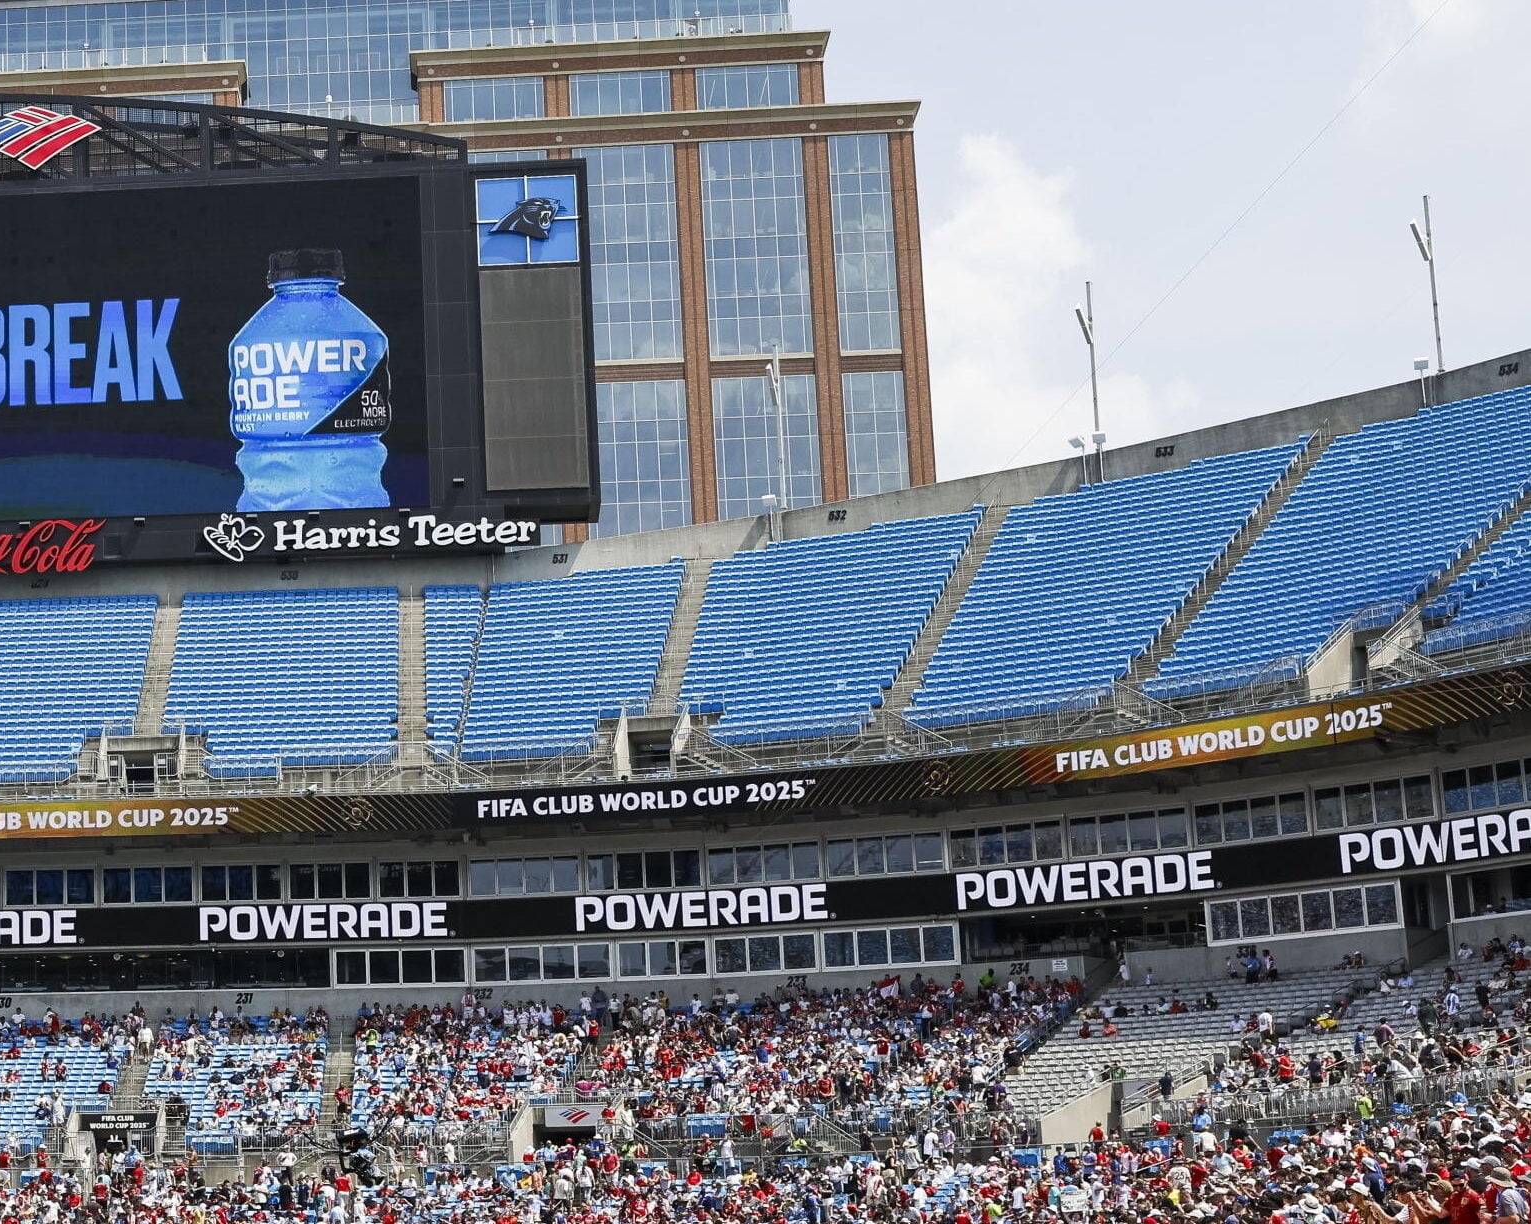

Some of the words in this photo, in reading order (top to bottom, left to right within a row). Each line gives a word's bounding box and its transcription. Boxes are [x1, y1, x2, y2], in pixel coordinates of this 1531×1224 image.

[234, 339, 366, 377] POWER
[1498, 363, 1519, 376] 534
[234, 375, 301, 410] ADE
[275, 411, 309, 421] BERRY
[363, 406, 386, 418] MORE
[1155, 445, 1175, 457] 533
[828, 510, 847, 521] 532
[273, 519, 400, 551] Harris
[408, 515, 536, 546] Teeter
[552, 553, 568, 565] 531
[1057, 749, 1109, 772] FIFA
[1114, 738, 1173, 766] CLUB
[1179, 724, 1265, 757] WORLD
[1271, 716, 1319, 742] CUP
[478, 799, 528, 818] FIFA
[533, 795, 594, 815] CLUB
[599, 789, 687, 812] WORLD
[693, 785, 740, 806] CUP
[27, 810, 112, 829] WORLD
[118, 808, 164, 827] CUP
[1339, 809, 1531, 874] POWERA
[1010, 963, 1030, 975] 234
[235, 992, 253, 1005] 231
[474, 988, 493, 999] 232
